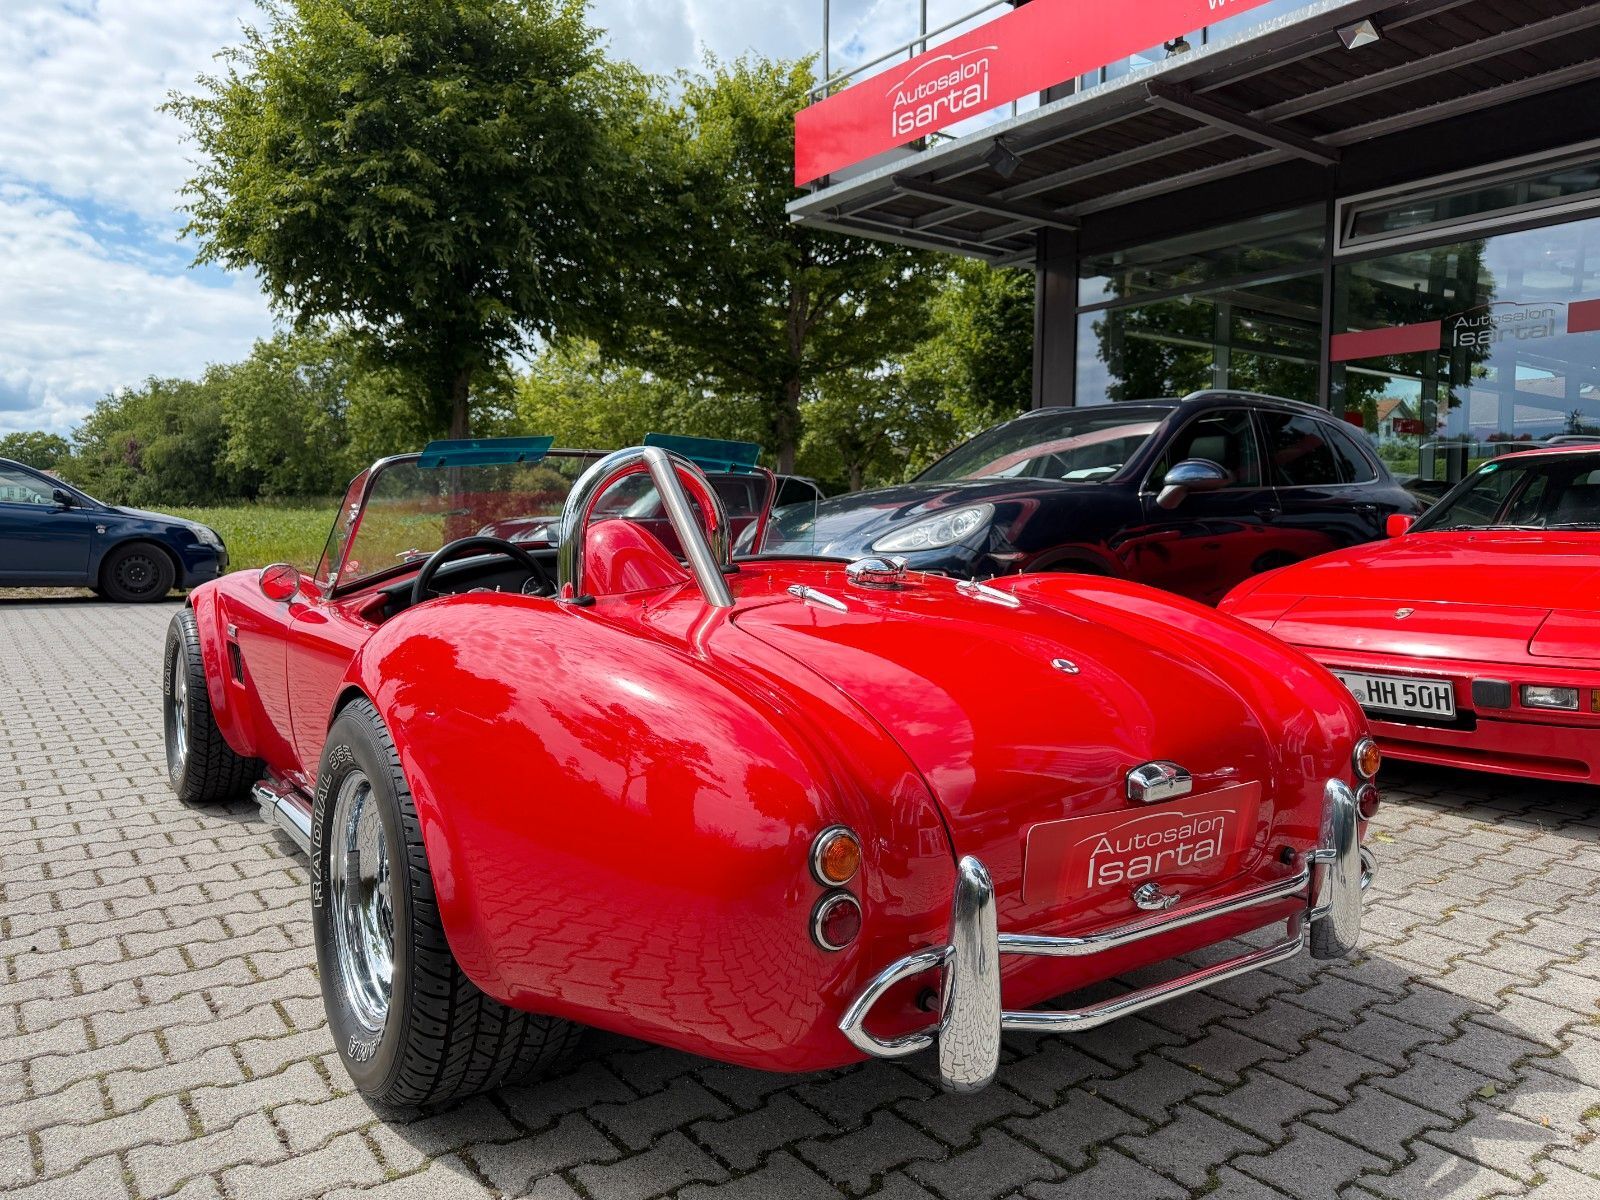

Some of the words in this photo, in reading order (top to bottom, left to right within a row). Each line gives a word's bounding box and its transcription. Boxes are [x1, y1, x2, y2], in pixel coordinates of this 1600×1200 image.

[892, 72, 988, 138] Isartal
[893, 57, 989, 111] Autosalon
[1452, 318, 1554, 347] Isartal
[1454, 308, 1555, 329] Autosalon
[1366, 680, 1397, 705] HH
[1402, 684, 1450, 711] 50H
[313, 774, 332, 908] RADIAL
[1087, 829, 1224, 888] Isartal
[1091, 816, 1225, 858] Autosalon
